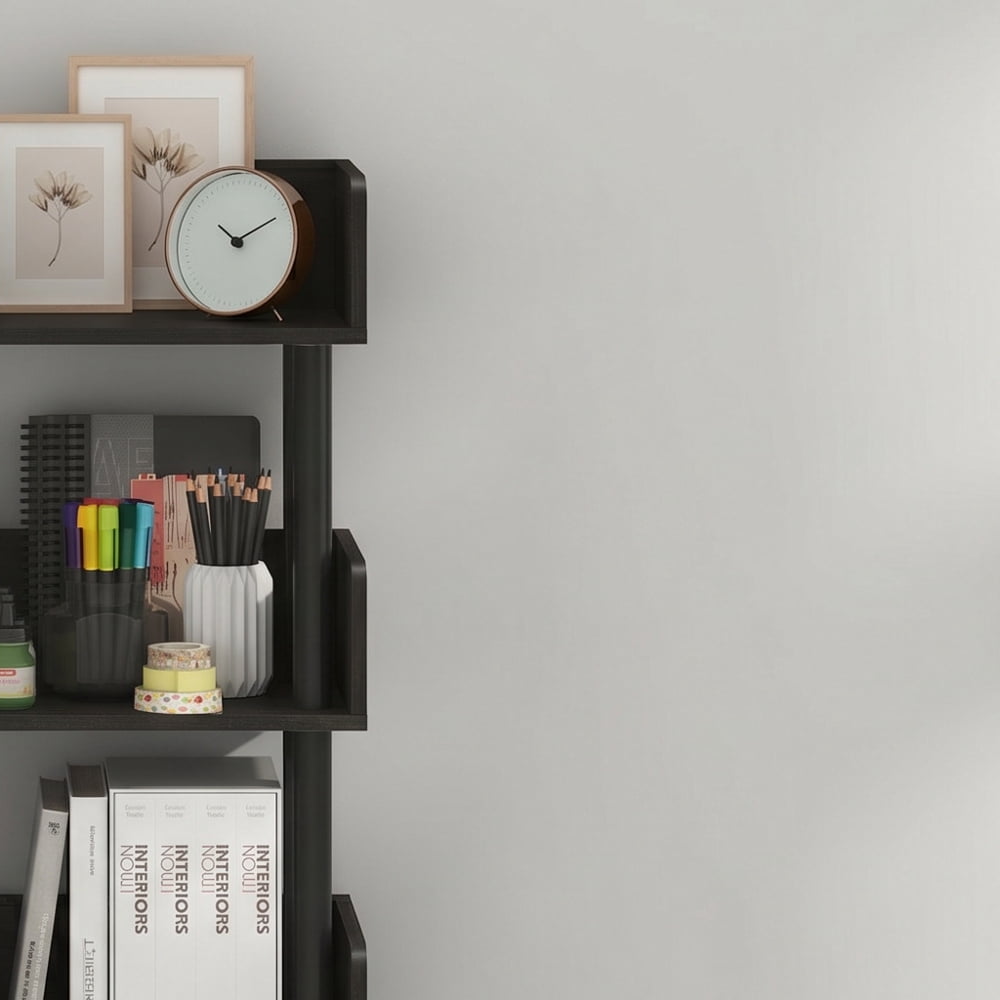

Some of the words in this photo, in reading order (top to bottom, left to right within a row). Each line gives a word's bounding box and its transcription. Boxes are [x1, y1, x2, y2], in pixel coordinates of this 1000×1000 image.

[135, 844, 148, 934] INTERIORS
[175, 844, 188, 934] INTERIORS
[216, 844, 229, 934] INTERIORS
[256, 844, 270, 934] INTERIORS
